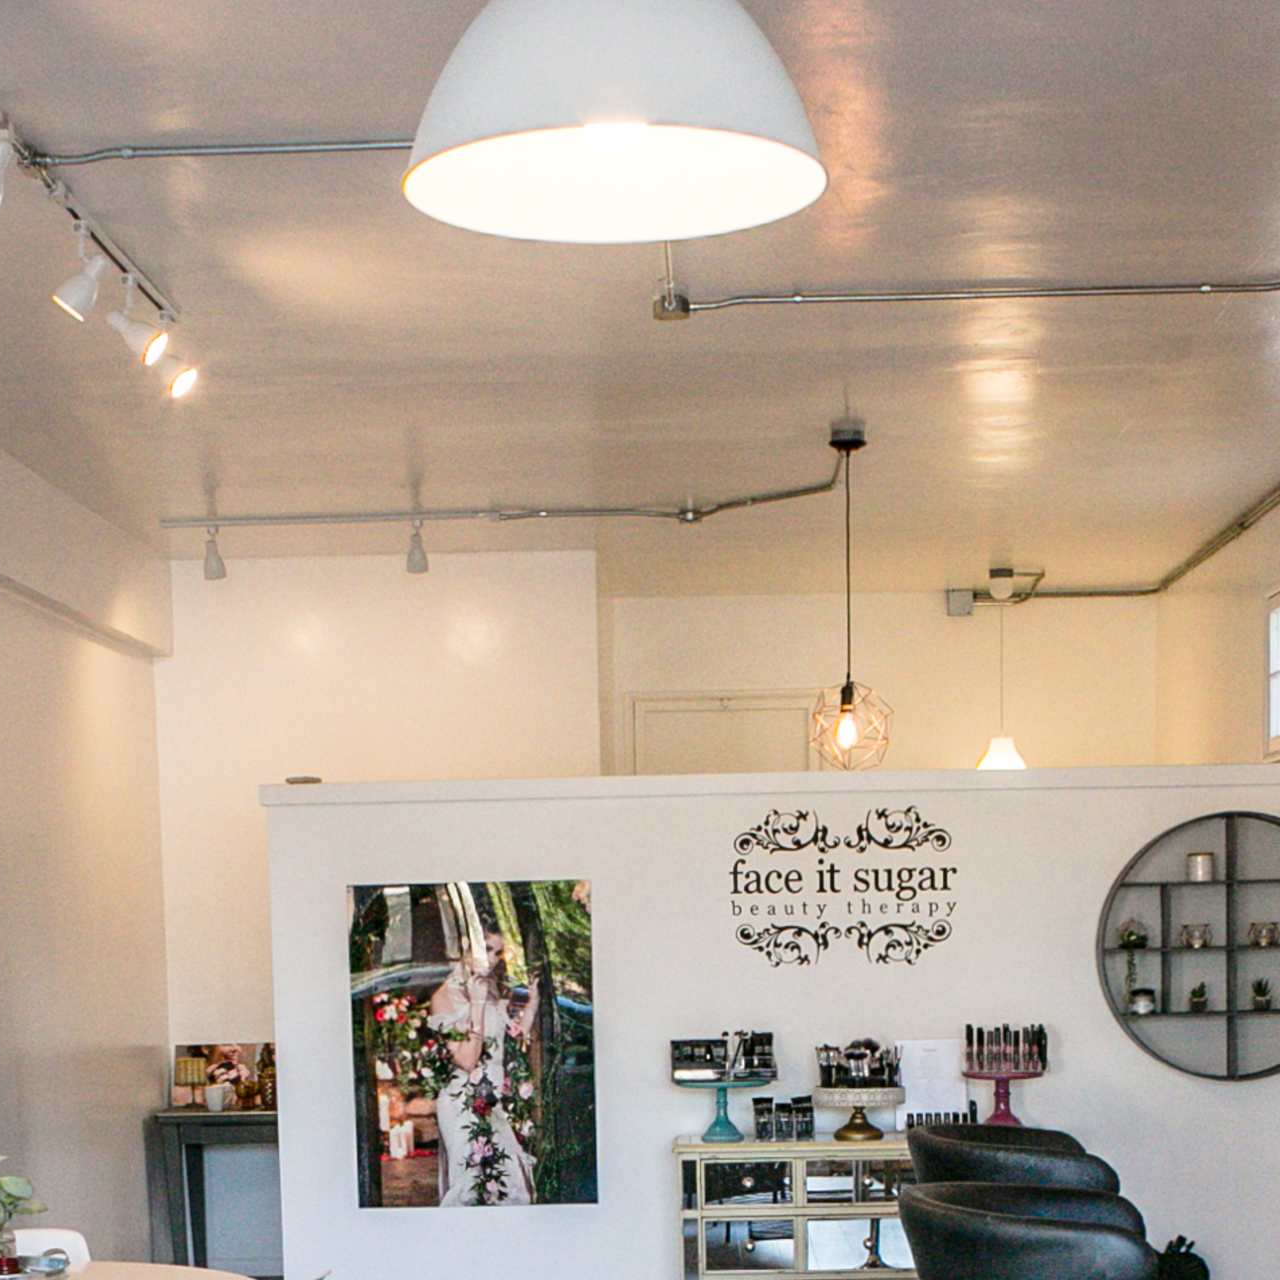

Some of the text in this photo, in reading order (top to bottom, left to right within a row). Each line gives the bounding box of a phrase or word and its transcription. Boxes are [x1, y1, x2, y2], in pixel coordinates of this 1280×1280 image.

[729, 858, 958, 902] face it sugar
[731, 898, 957, 920] beauty therapy
